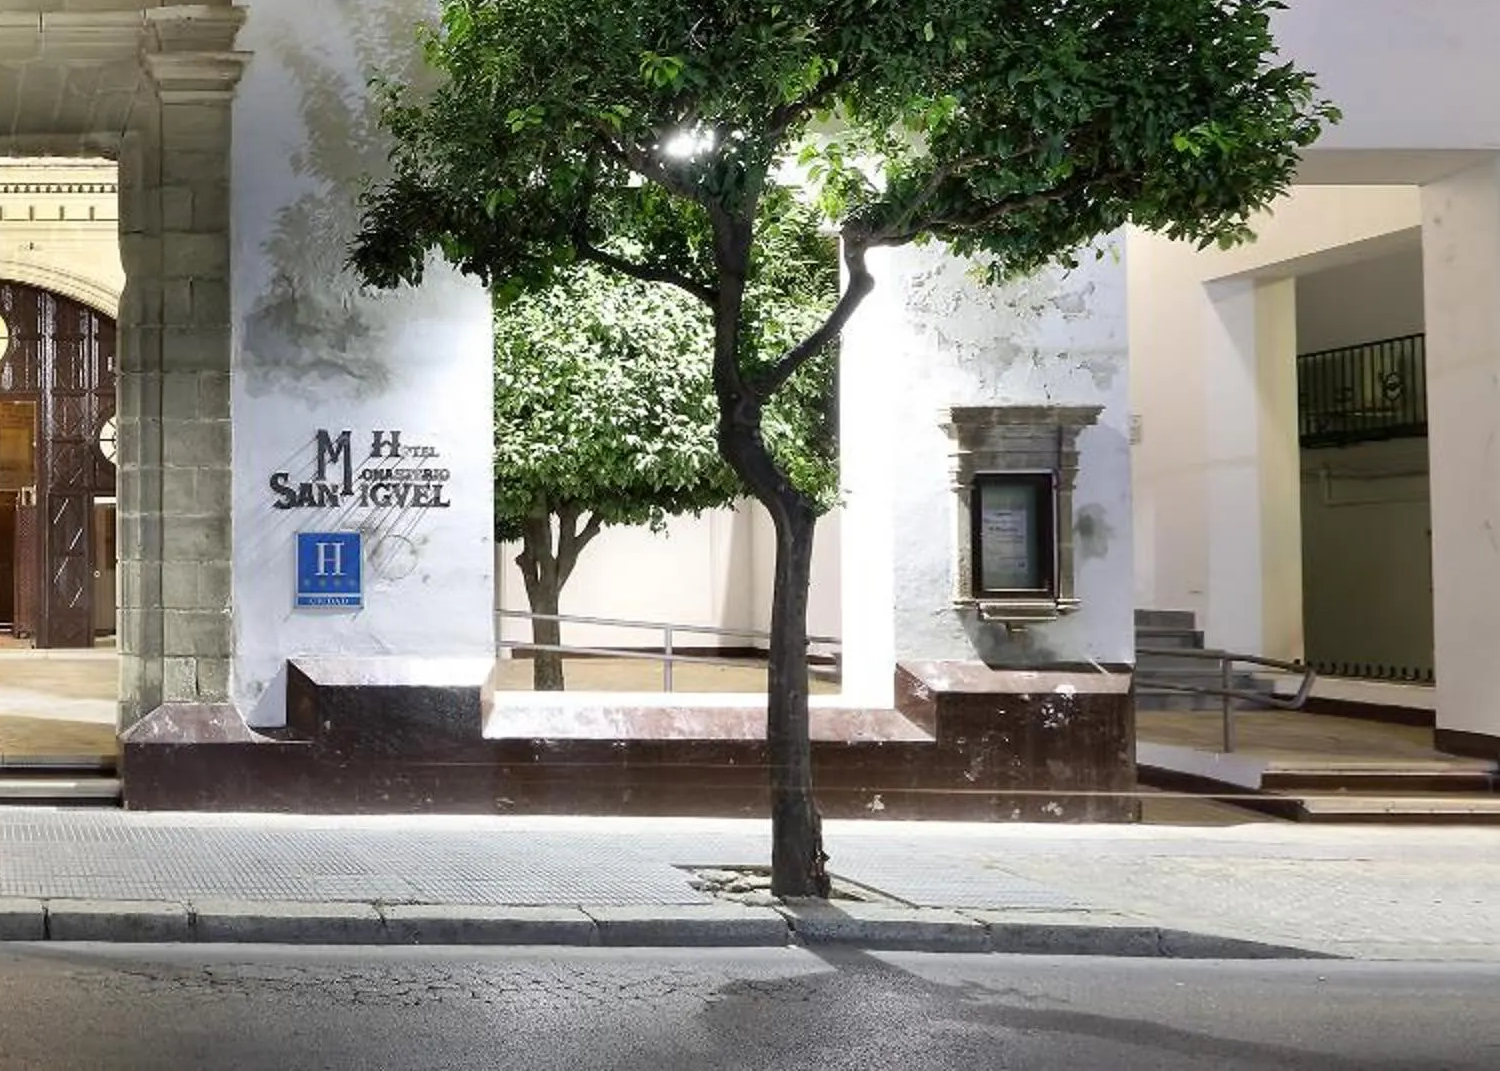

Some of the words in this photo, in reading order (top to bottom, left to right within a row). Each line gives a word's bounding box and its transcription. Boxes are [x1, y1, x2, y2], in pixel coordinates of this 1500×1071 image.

[371, 430, 440, 457] HOTEL
[269, 472, 341, 509] SAN
[315, 542, 346, 576] H
